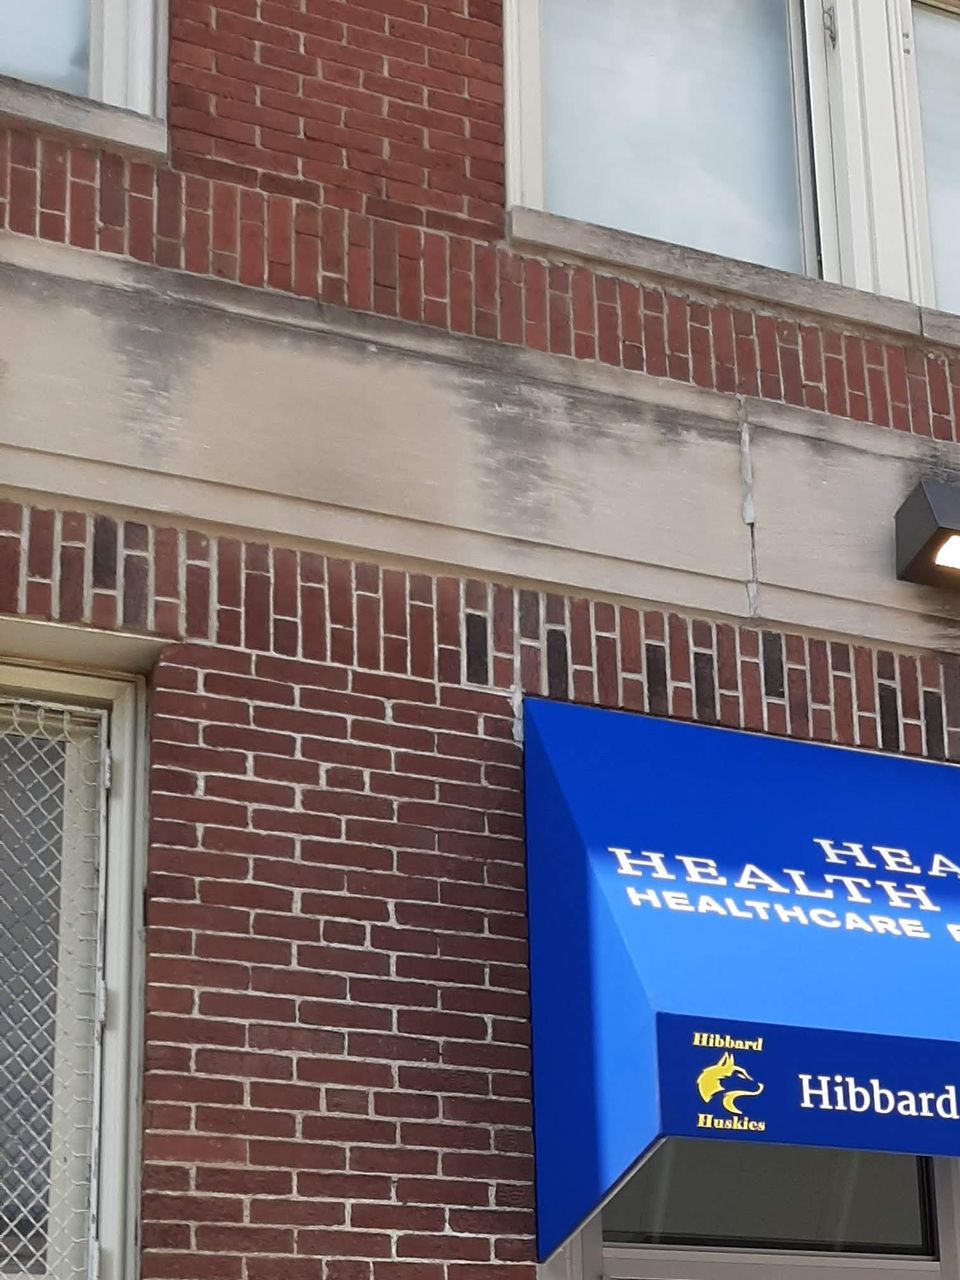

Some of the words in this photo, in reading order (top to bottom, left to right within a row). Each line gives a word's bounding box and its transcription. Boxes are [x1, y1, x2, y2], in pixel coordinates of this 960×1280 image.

[607, 847, 941, 912] HEALTH
[626, 887, 931, 939] HEALTHCARE
[693, 1032, 763, 1051] Hibbard
[798, 1073, 960, 1120] Hibbard
[697, 1113, 766, 1132] Huskies
